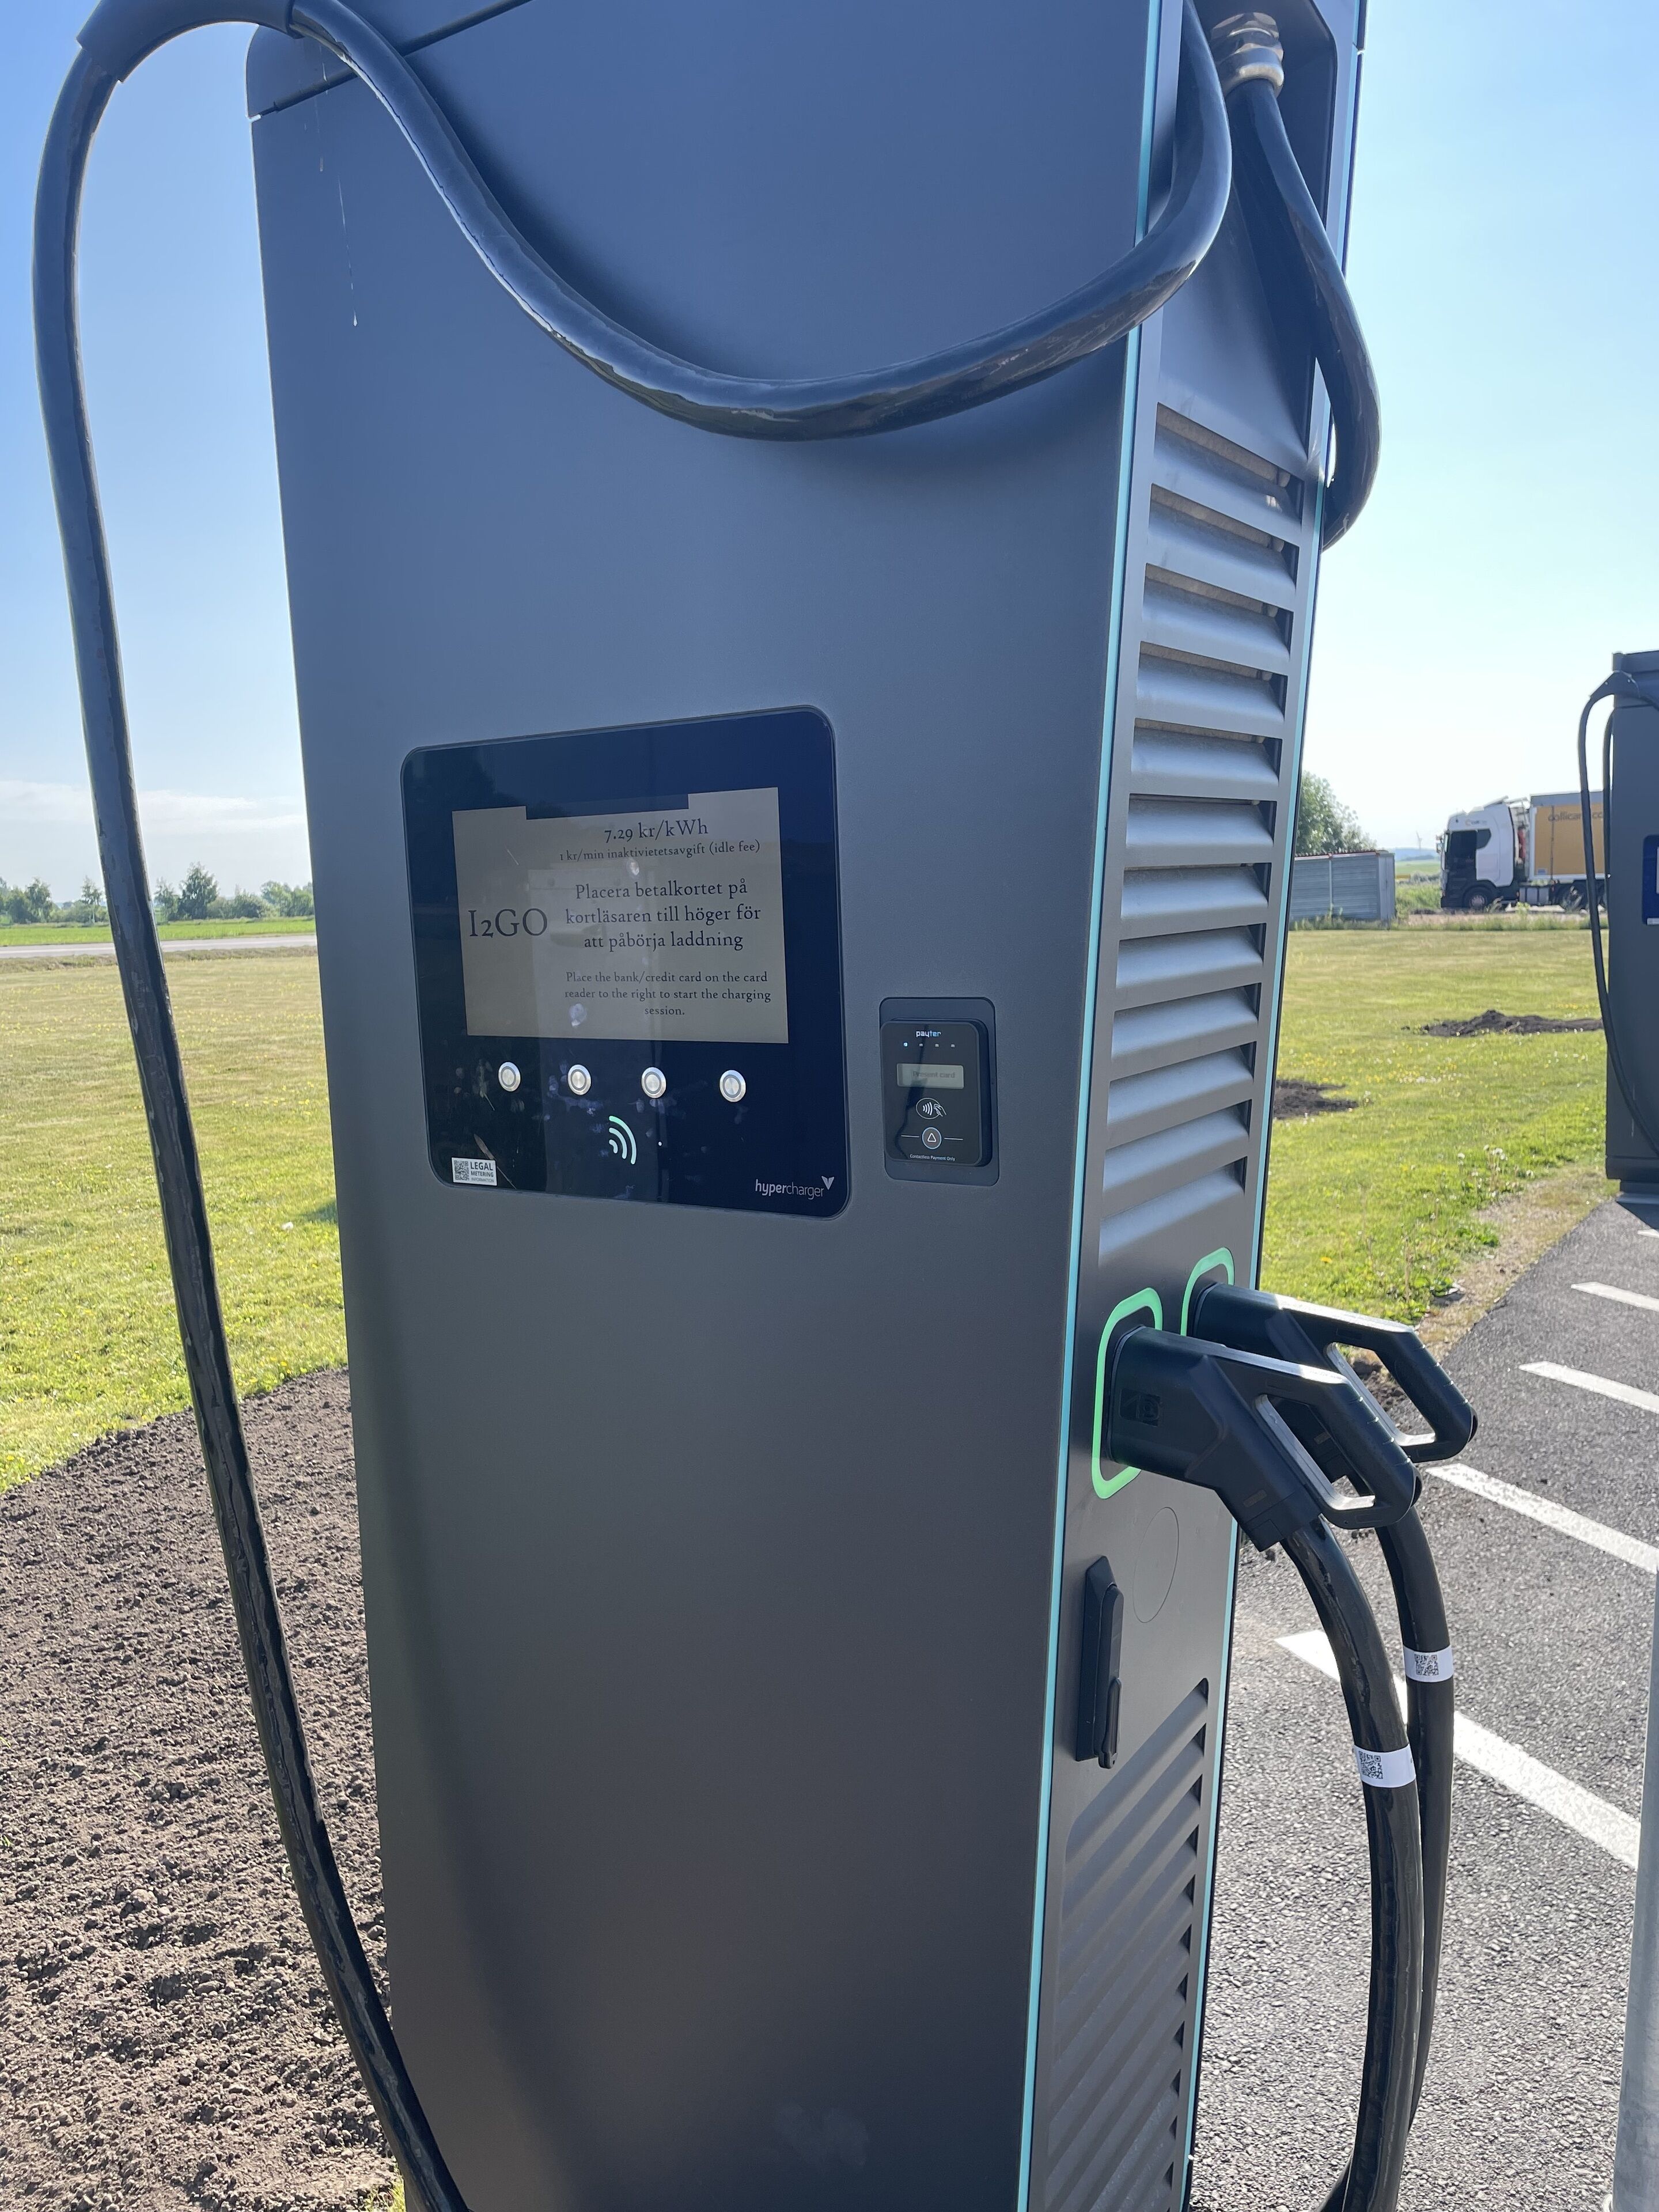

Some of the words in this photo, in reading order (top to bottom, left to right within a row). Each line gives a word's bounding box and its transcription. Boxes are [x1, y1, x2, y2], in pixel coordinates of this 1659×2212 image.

[604, 828, 633, 844] 7.29
[638, 817, 709, 841] kr/kWh
[566, 849, 604, 862] kr/min
[607, 844, 706, 859] inaktivietetsavgift
[709, 841, 735, 856] (idle
[738, 839, 760, 854] fee)
[575, 883, 631, 899] Placera
[634, 880, 724, 898] betalkortet
[728, 877, 748, 900] på
[468, 908, 548, 937] I2GO
[565, 907, 652, 924] kortläsaren
[657, 905, 680, 922] till
[684, 904, 731, 926] höger
[736, 903, 761, 920] för
[584, 937, 604, 948] att
[608, 931, 666, 953] påbörja
[670, 930, 744, 952] laddning
[566, 971, 592, 982] Place
[595, 971, 611, 982] the
[613, 971, 676, 984] bank/credit
[679, 971, 702, 982] card
[704, 972, 720, 982] on
[722, 971, 741, 982] the
[743, 971, 768, 982] card
[565, 988, 596, 998] reader
[599, 990, 609, 999] to
[611, 988, 628, 998] the
[631, 987, 657, 1002] right
[660, 991, 671, 999] to
[673, 990, 698, 999] start
[701, 988, 718, 999] the
[721, 988, 771, 1003] charging
[644, 1005, 685, 1016] session.
[470, 1161, 493, 1171] LEGAL
[755, 1179, 825, 1200] hypercharger
